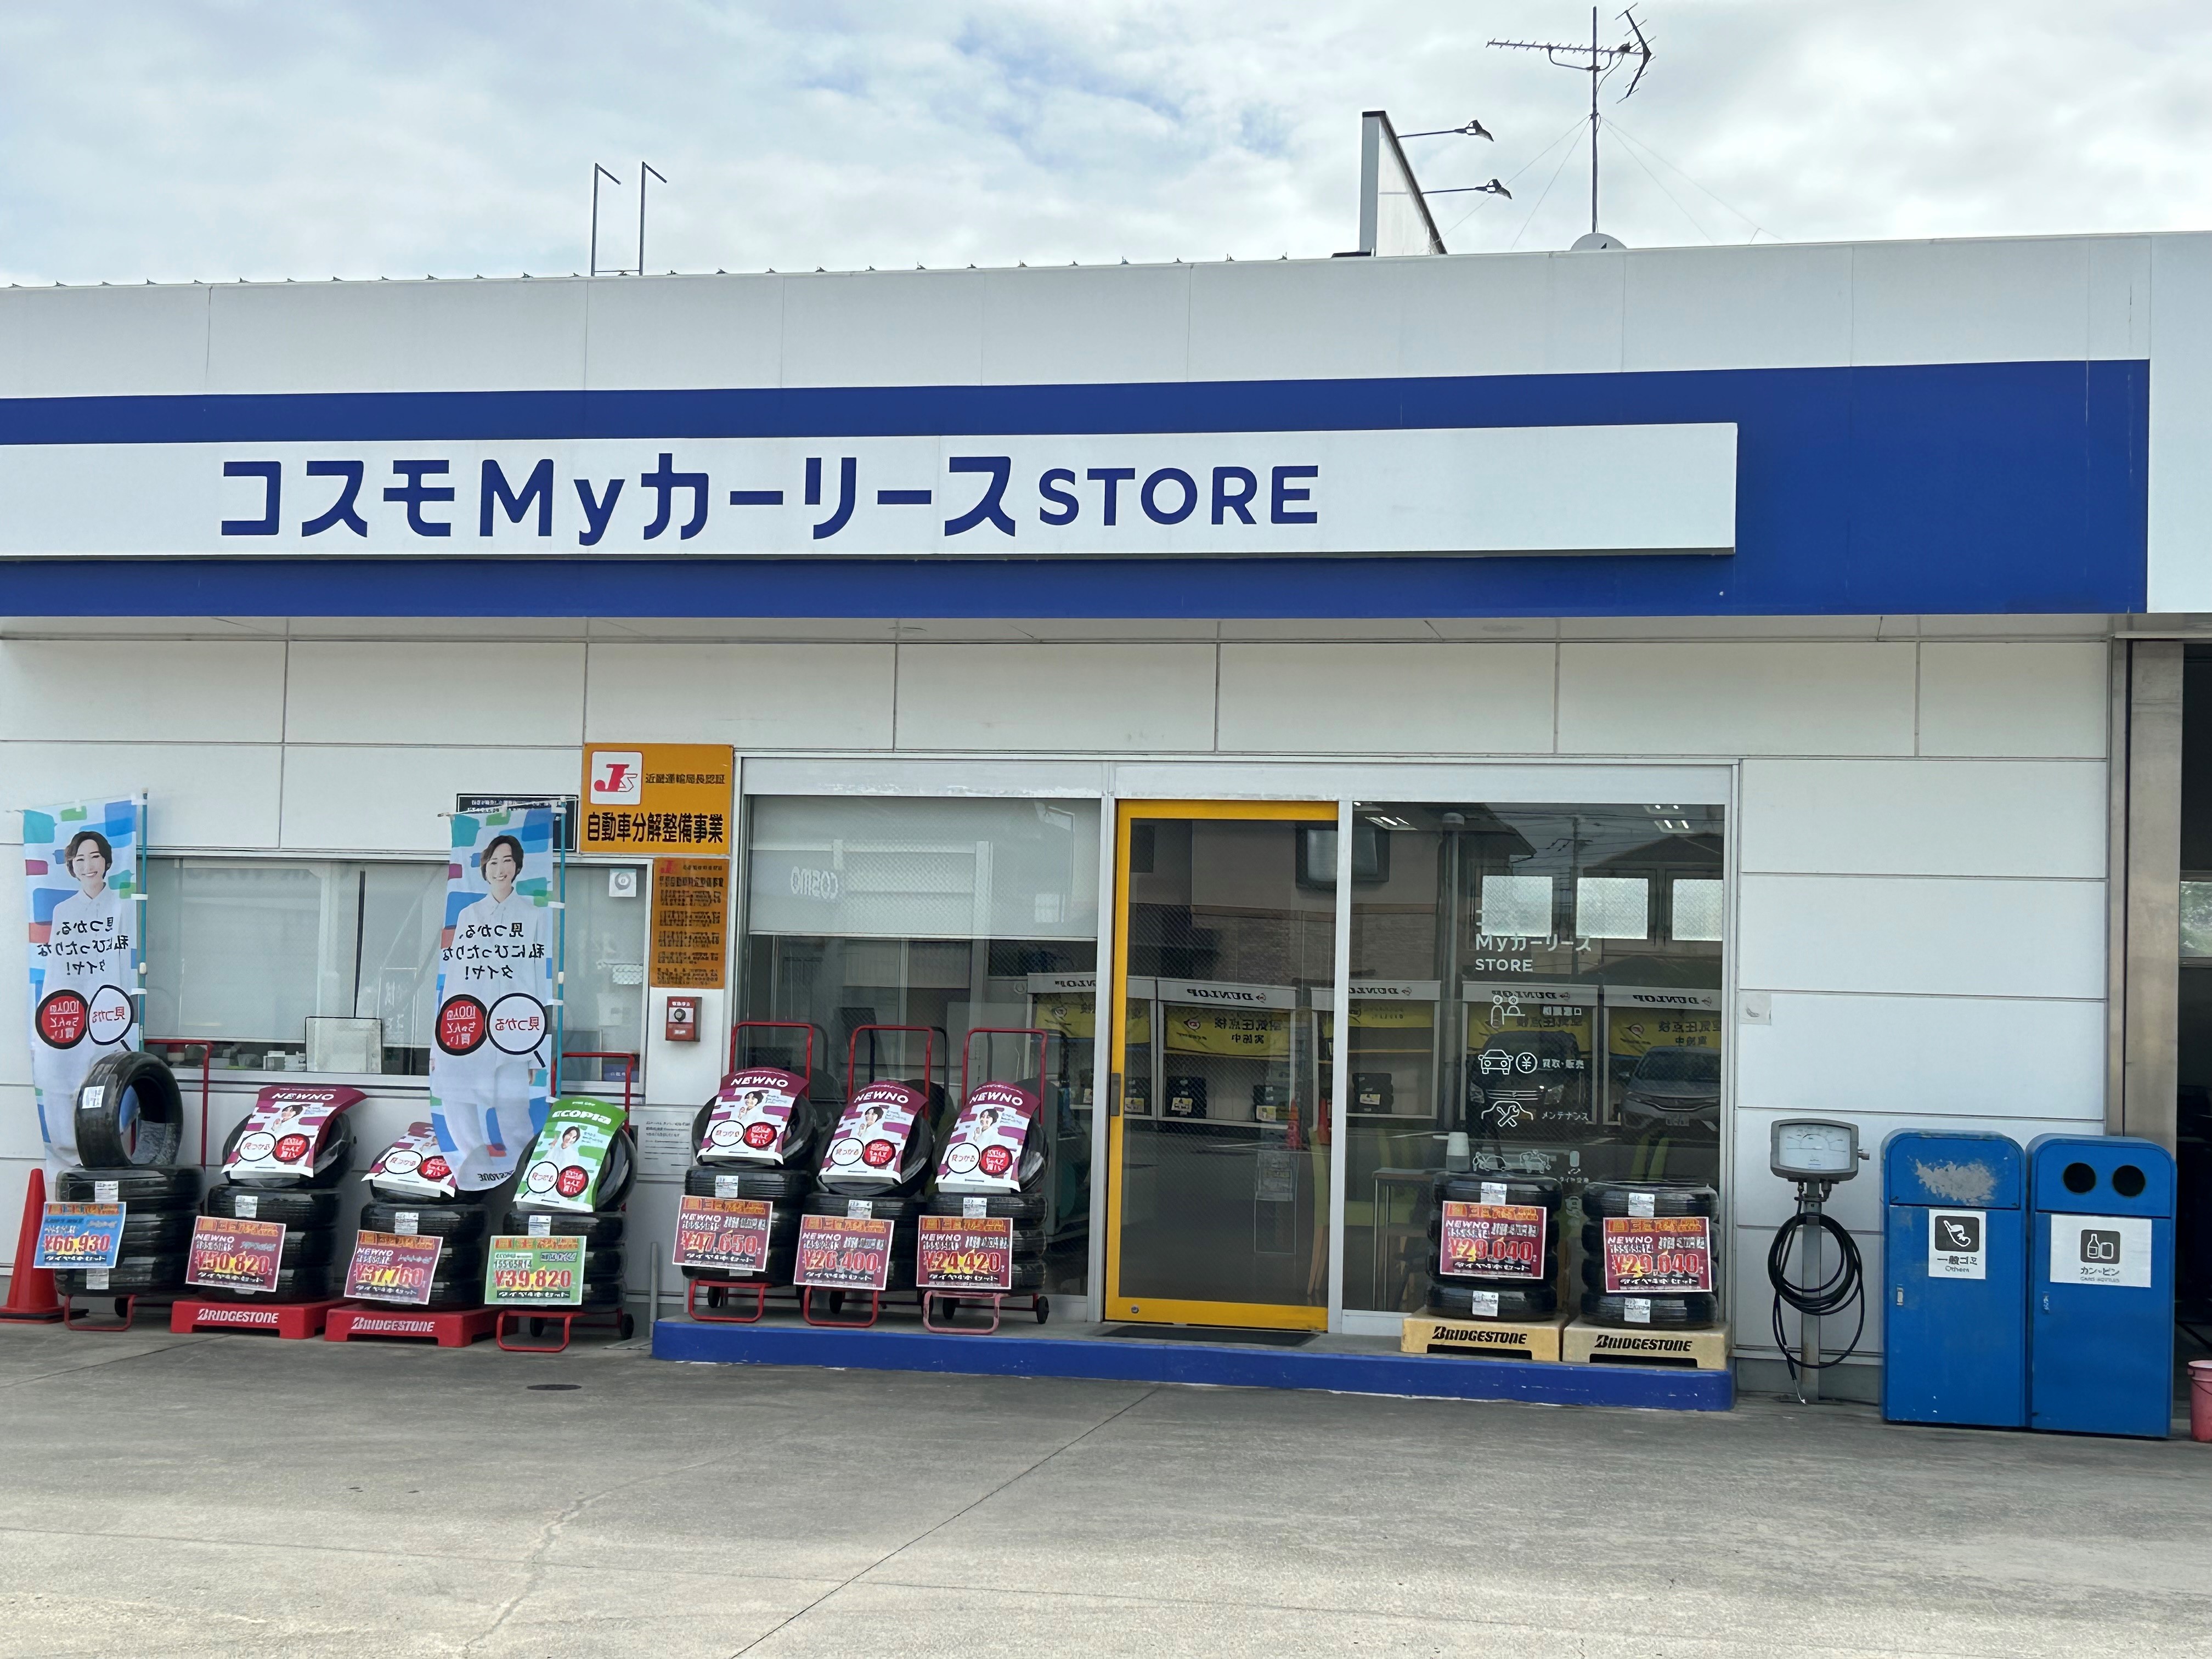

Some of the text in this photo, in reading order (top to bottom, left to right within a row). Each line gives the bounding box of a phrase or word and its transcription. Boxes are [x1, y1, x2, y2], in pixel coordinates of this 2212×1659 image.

[588, 811, 723, 843] 自動車分解整備事業
[1475, 958, 1533, 972] STORE
[730, 1076, 789, 1087] NEWNO
[854, 1091, 909, 1104] NEWNO
[969, 1092, 1024, 1106] NEWNO
[1542, 1111, 1589, 1121] メンテナンス
[681, 1213, 721, 1222] NEWNO
[1446, 1220, 1490, 1229] NEWNO
[195, 1233, 235, 1243] NEWNO
[802, 1232, 842, 1241] NEWNO
[921, 1233, 961, 1242] NEWNO
[1607, 1235, 1653, 1244] NEWNO
[44, 1234, 110, 1252] ¥66,930
[357, 1248, 394, 1256] NEWNO
[495, 1269, 572, 1289] ¥39,820
[197, 1308, 279, 1323] BRIDGESTONE
[1431, 1325, 1528, 1344] BRIDGESTONE
[1594, 1334, 1693, 1352] BRIDGESTONE
